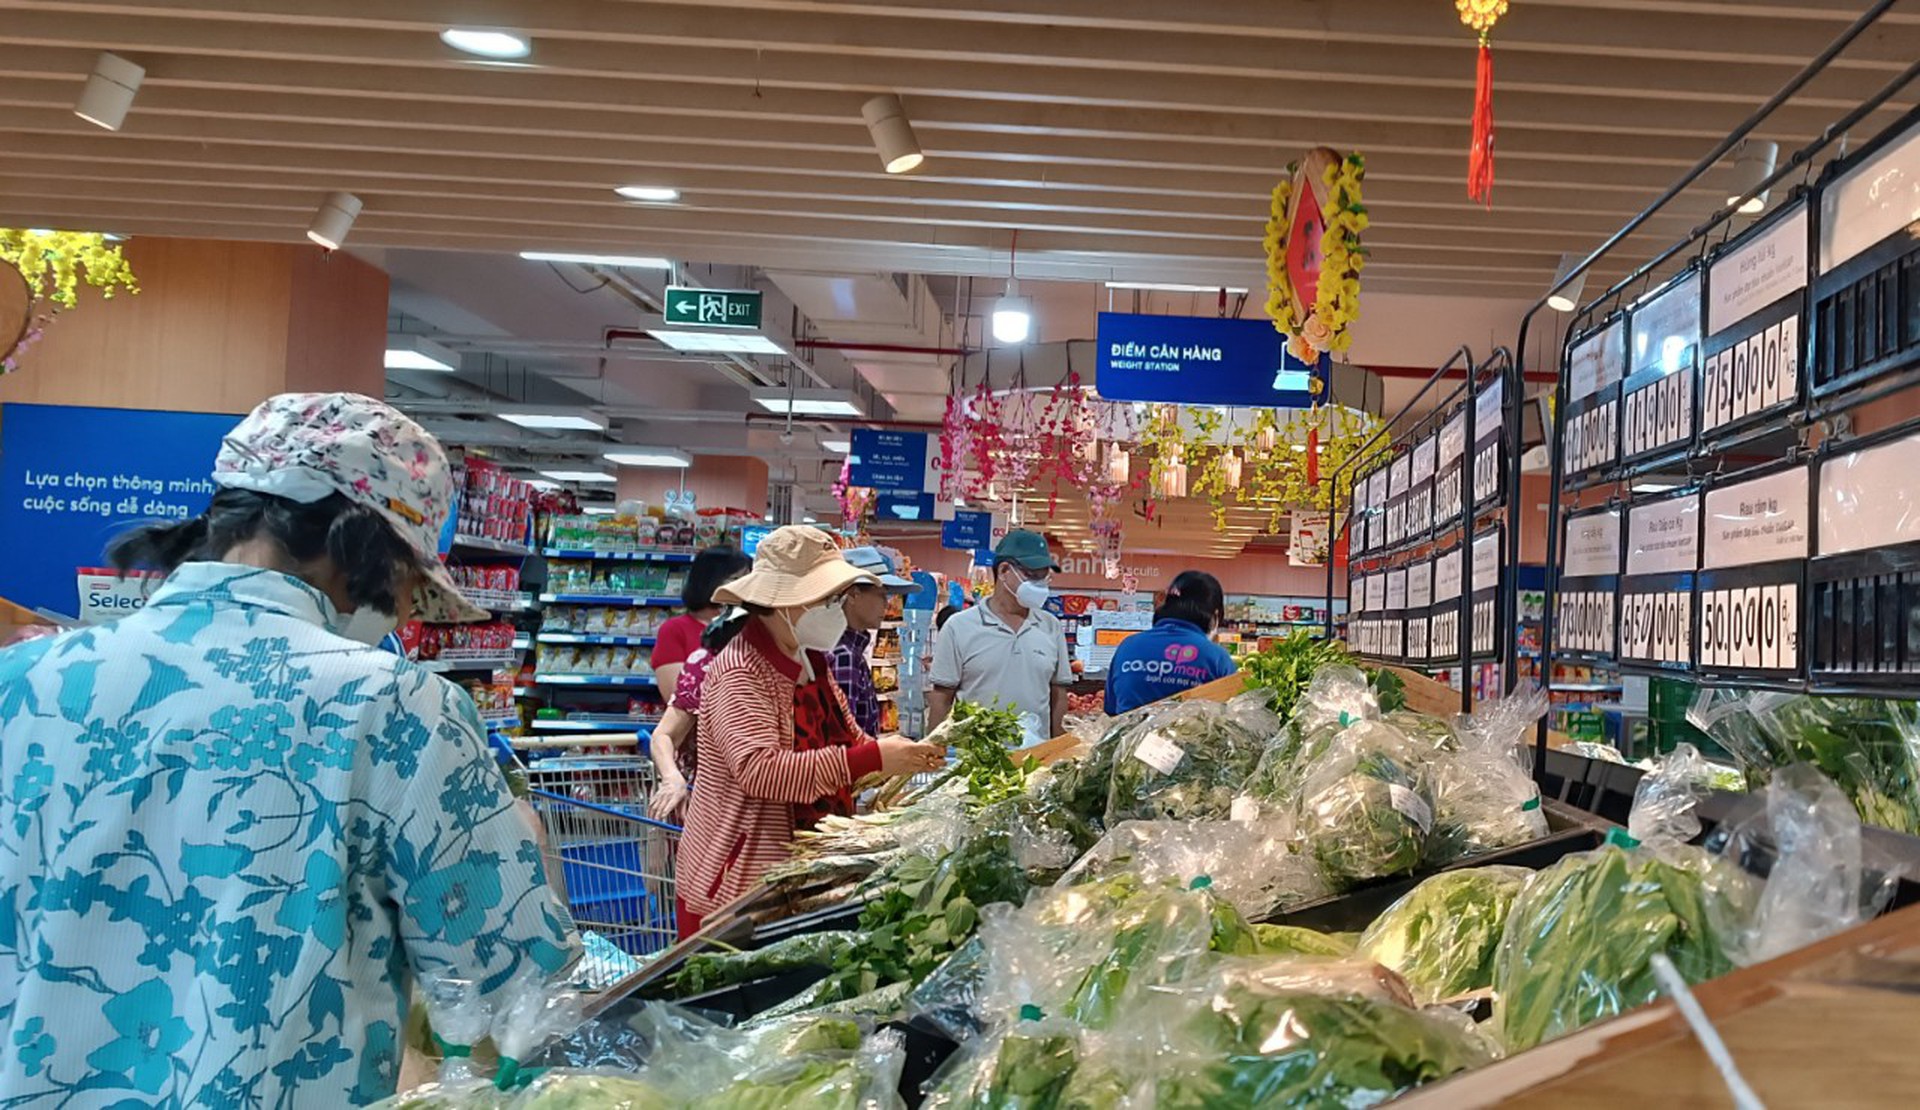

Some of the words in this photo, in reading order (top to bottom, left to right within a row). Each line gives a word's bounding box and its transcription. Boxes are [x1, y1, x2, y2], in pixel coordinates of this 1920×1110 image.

[728, 302, 751, 316] EXIT
[1111, 341, 1146, 357] ĐIỂM
[1149, 343, 1179, 359] CÂN
[1182, 345, 1222, 361] HÀNG
[1110, 360, 1143, 370] WEIGHT
[1144, 361, 1179, 372] STATION
[25, 469, 60, 490] Lựa
[64, 472, 107, 492] chọn
[112, 474, 164, 495] thông
[169, 478, 216, 496] minh,
[23, 495, 65, 514] cuộc
[70, 495, 112, 516] sống
[116, 496, 139, 514] dễ
[143, 499, 189, 519] dàng
[1704, 596, 1775, 651] 50.000
